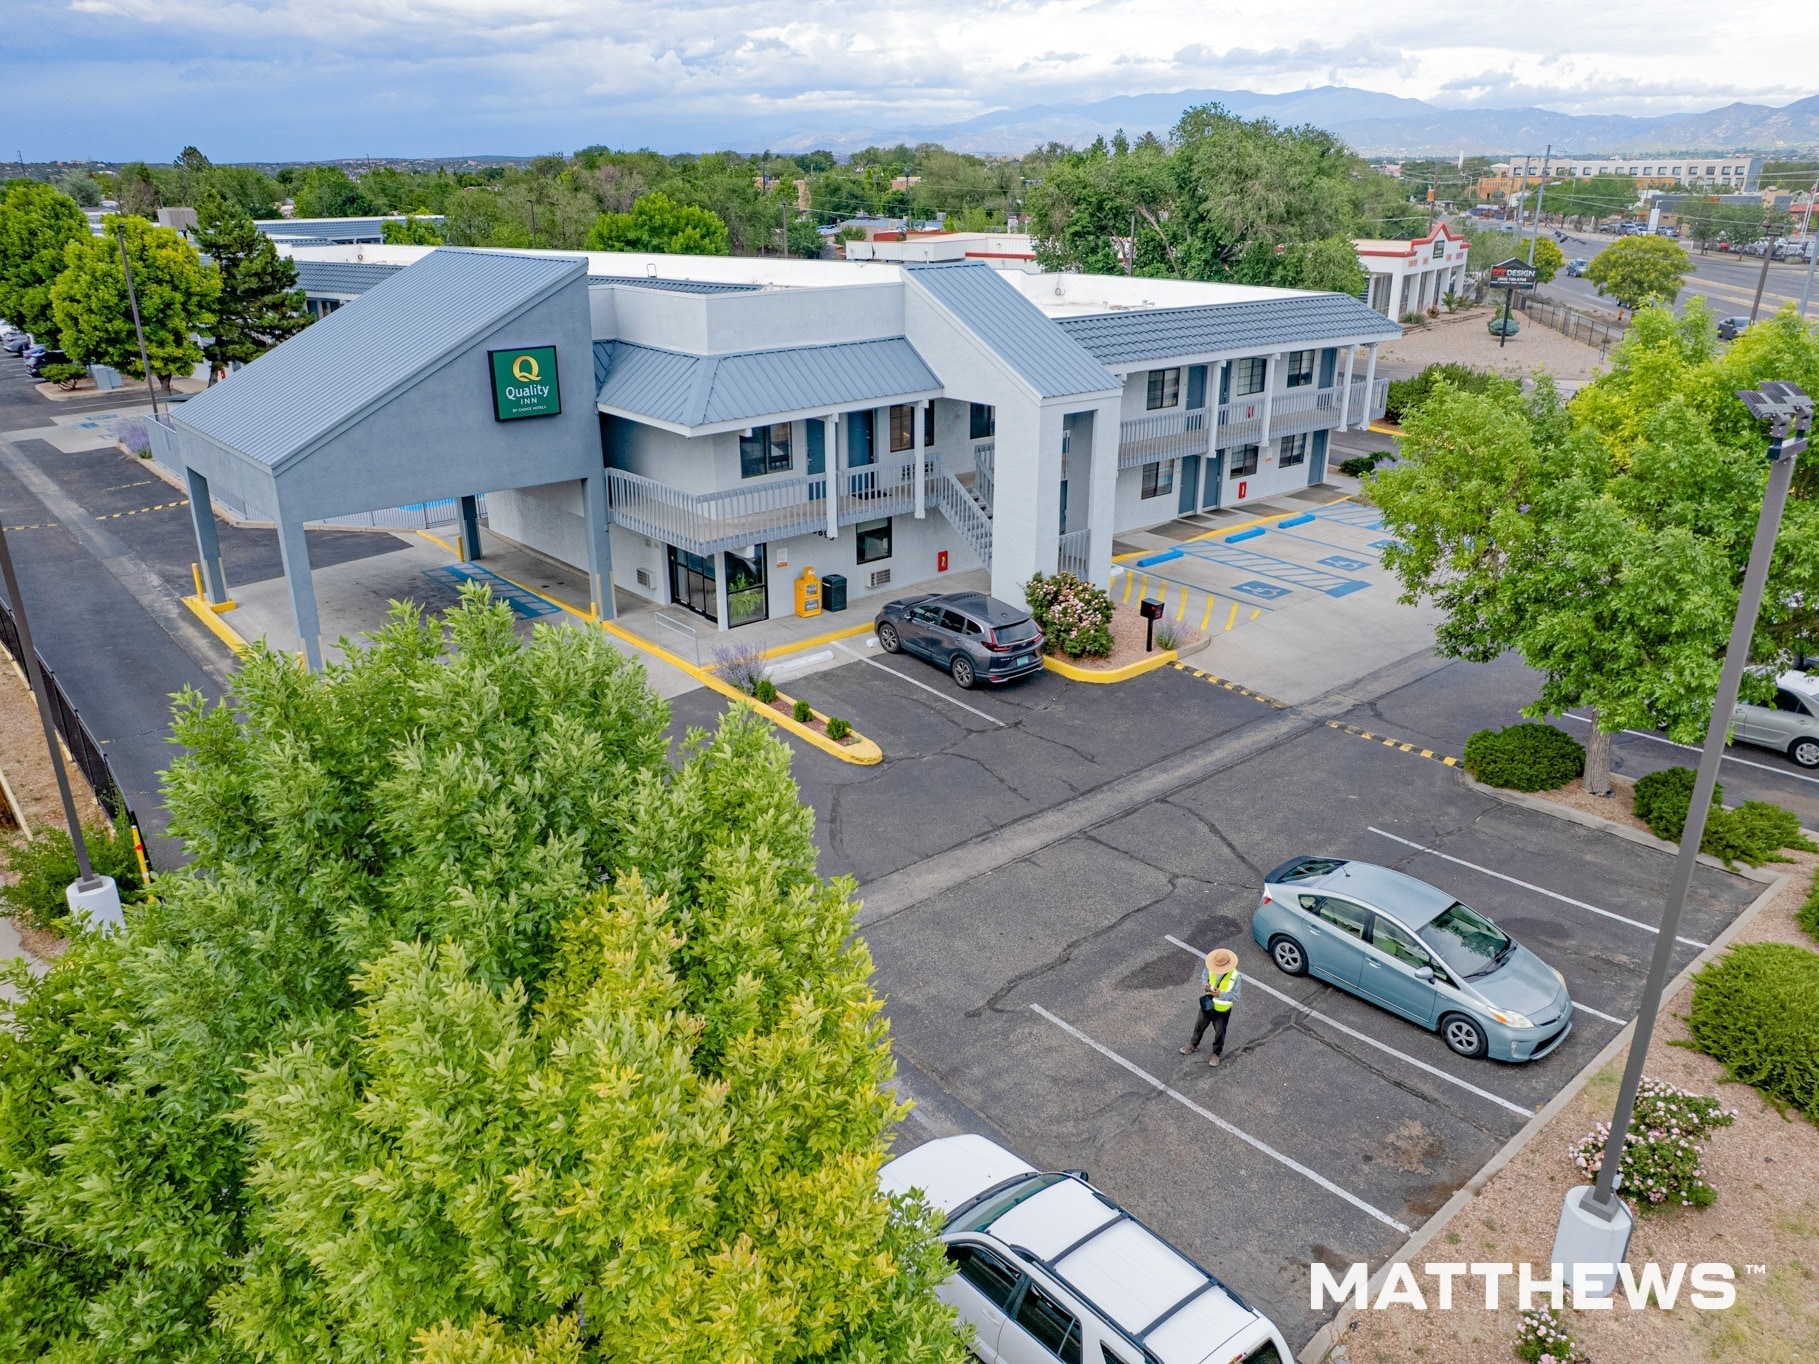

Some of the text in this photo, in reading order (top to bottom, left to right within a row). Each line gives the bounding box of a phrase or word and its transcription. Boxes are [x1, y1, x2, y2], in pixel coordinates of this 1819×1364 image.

[512, 355, 542, 382] Q
[505, 384, 549, 400] Quality
[520, 397, 537, 405] INN
